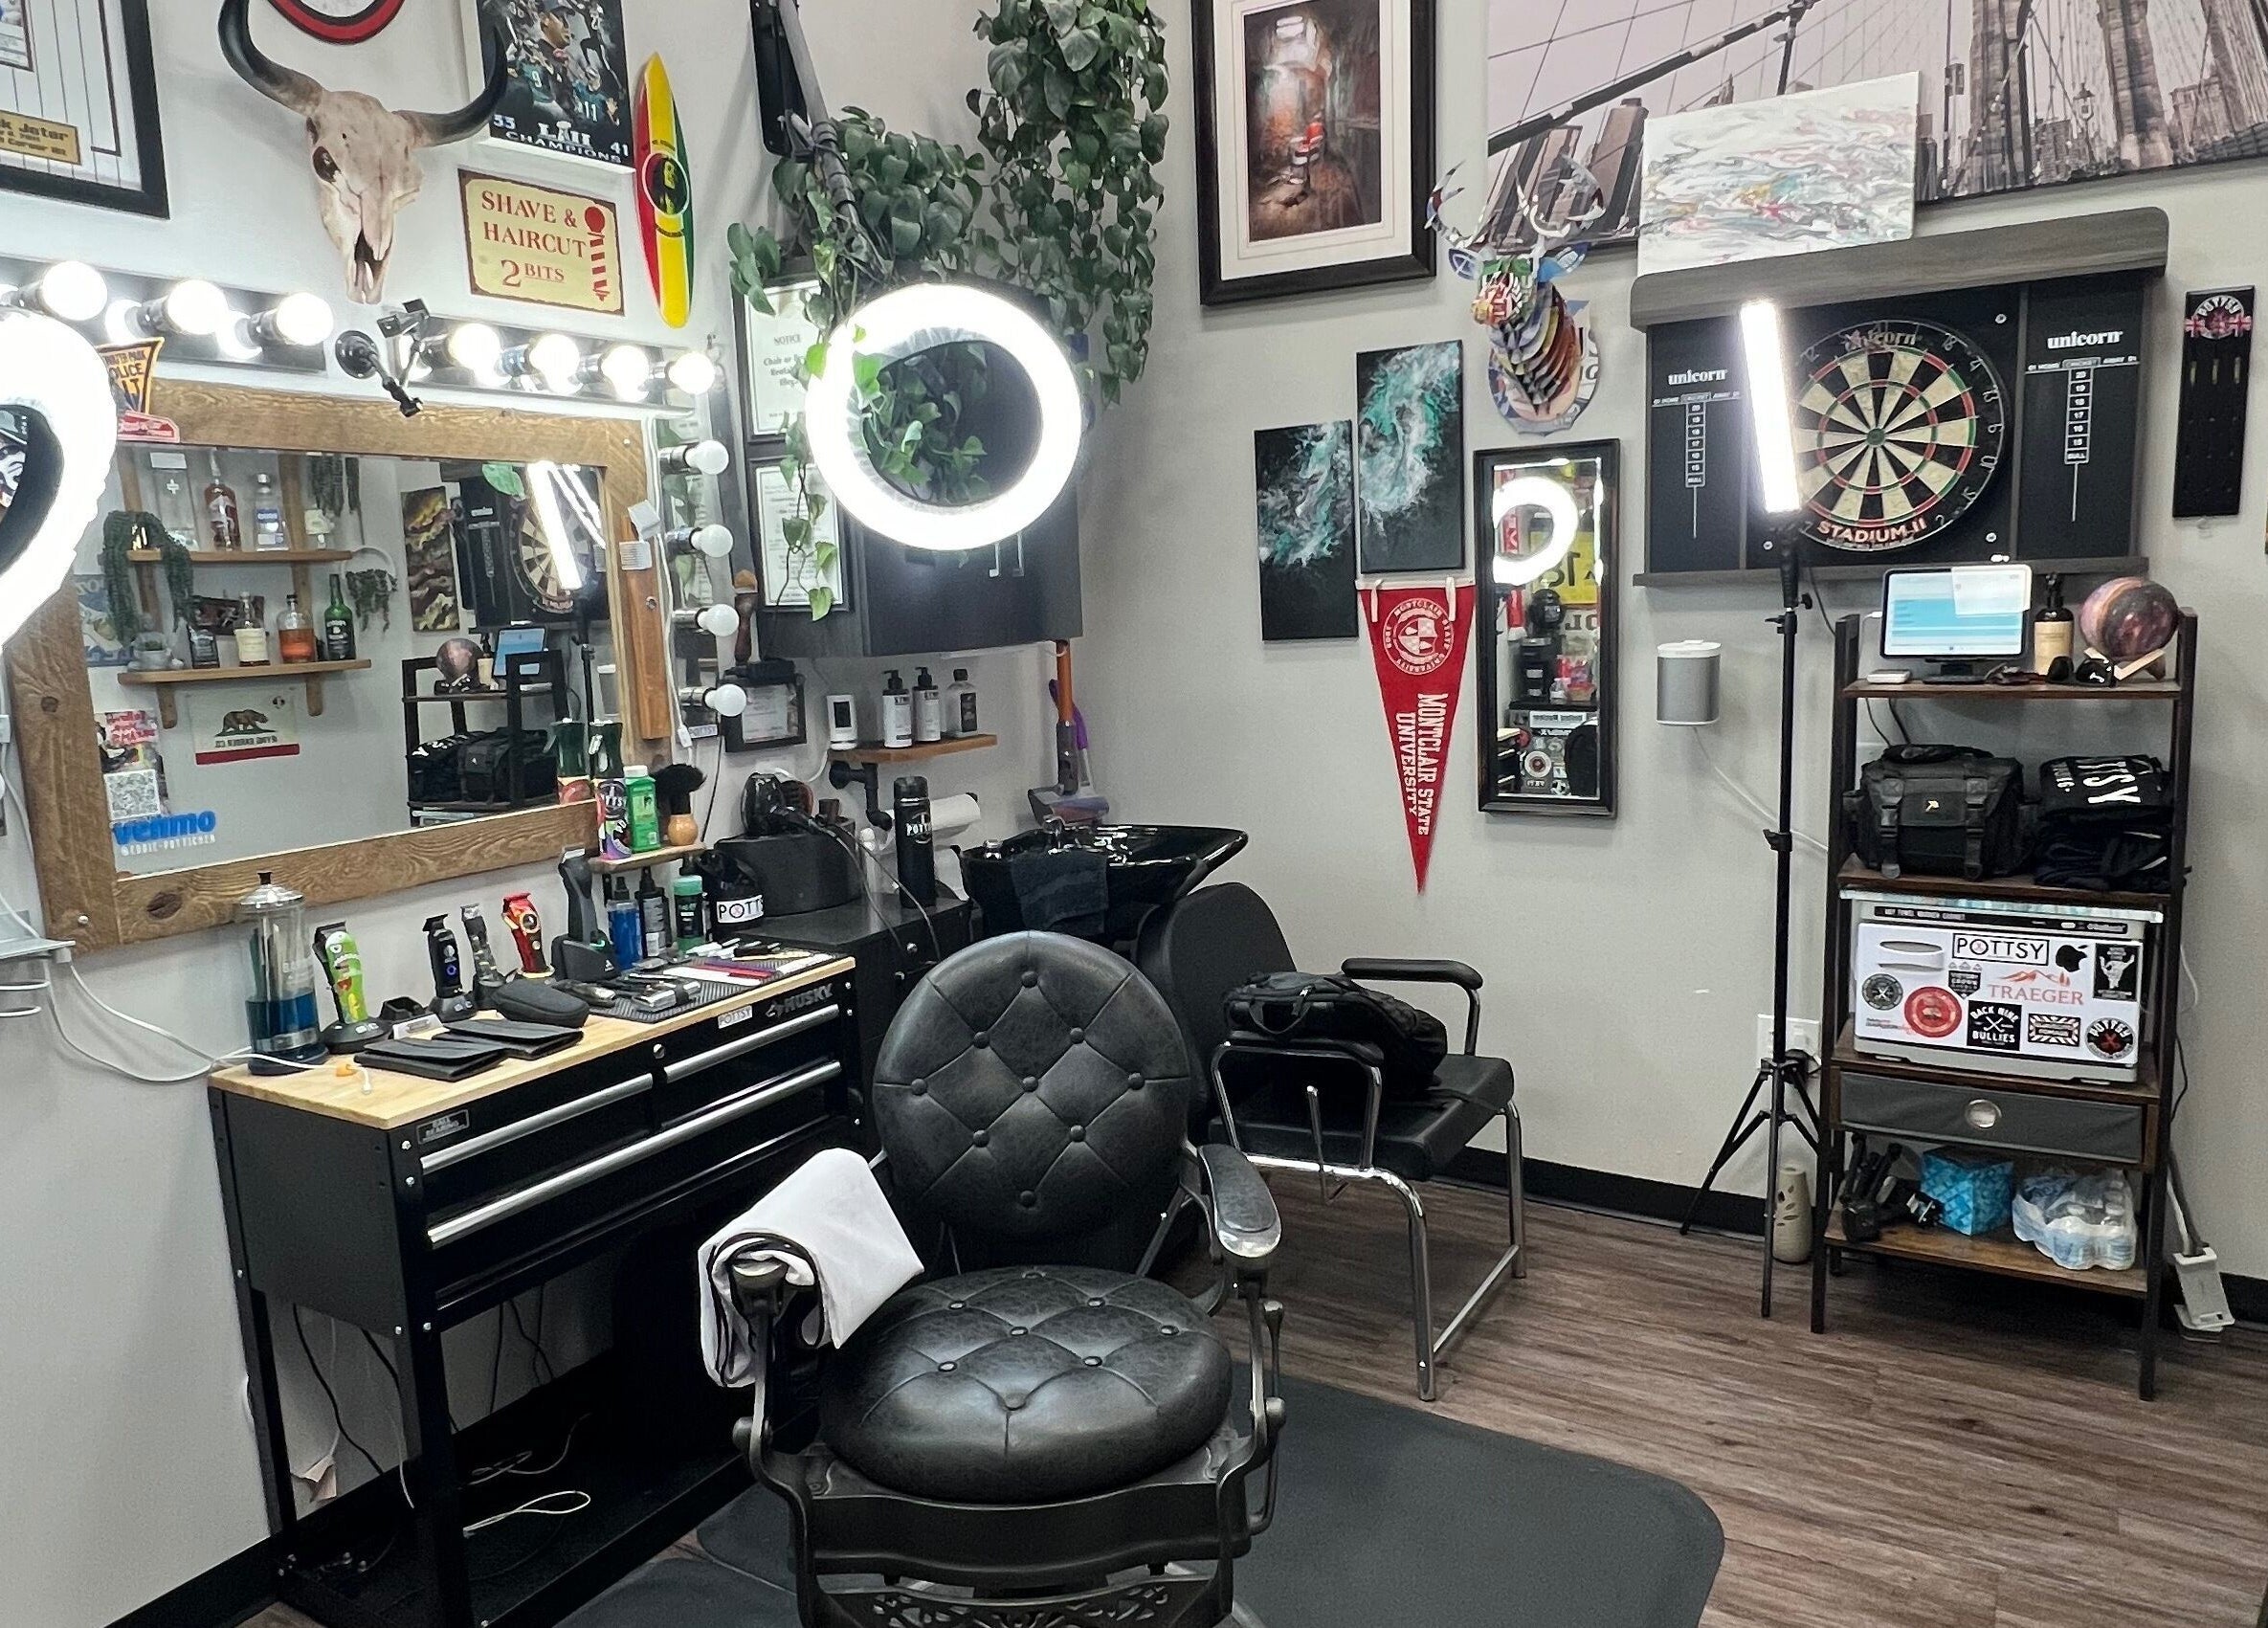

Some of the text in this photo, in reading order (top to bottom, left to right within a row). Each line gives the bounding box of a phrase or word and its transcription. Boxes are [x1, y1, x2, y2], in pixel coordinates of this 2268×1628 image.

[505, 131, 622, 164] CHAMPIONS
[481, 190, 578, 228] SHAVE &
[483, 221, 587, 257] HAIRCUT
[500, 259, 566, 287] 2 BITS
[2197, 297, 2241, 317] POTTSY
[2047, 330, 2123, 349] unicorn
[107, 363, 145, 380] OLICE
[1668, 368, 1728, 385] unicorn
[1395, 711, 1417, 816] UNIVERSITY
[1417, 693, 1449, 836] MONTCLAIR STATE
[113, 811, 216, 846] venmo
[1957, 937, 2044, 960] POTTSY
[785, 983, 833, 1013] HUSKY
[1988, 984, 2084, 1005] TRAEGER
[719, 1007, 752, 1026] POTTSY
[1969, 1006, 1993, 1019] BACK
[1972, 1030, 2015, 1043] BULLIES
[2090, 1019, 2131, 1037] POTTSY
